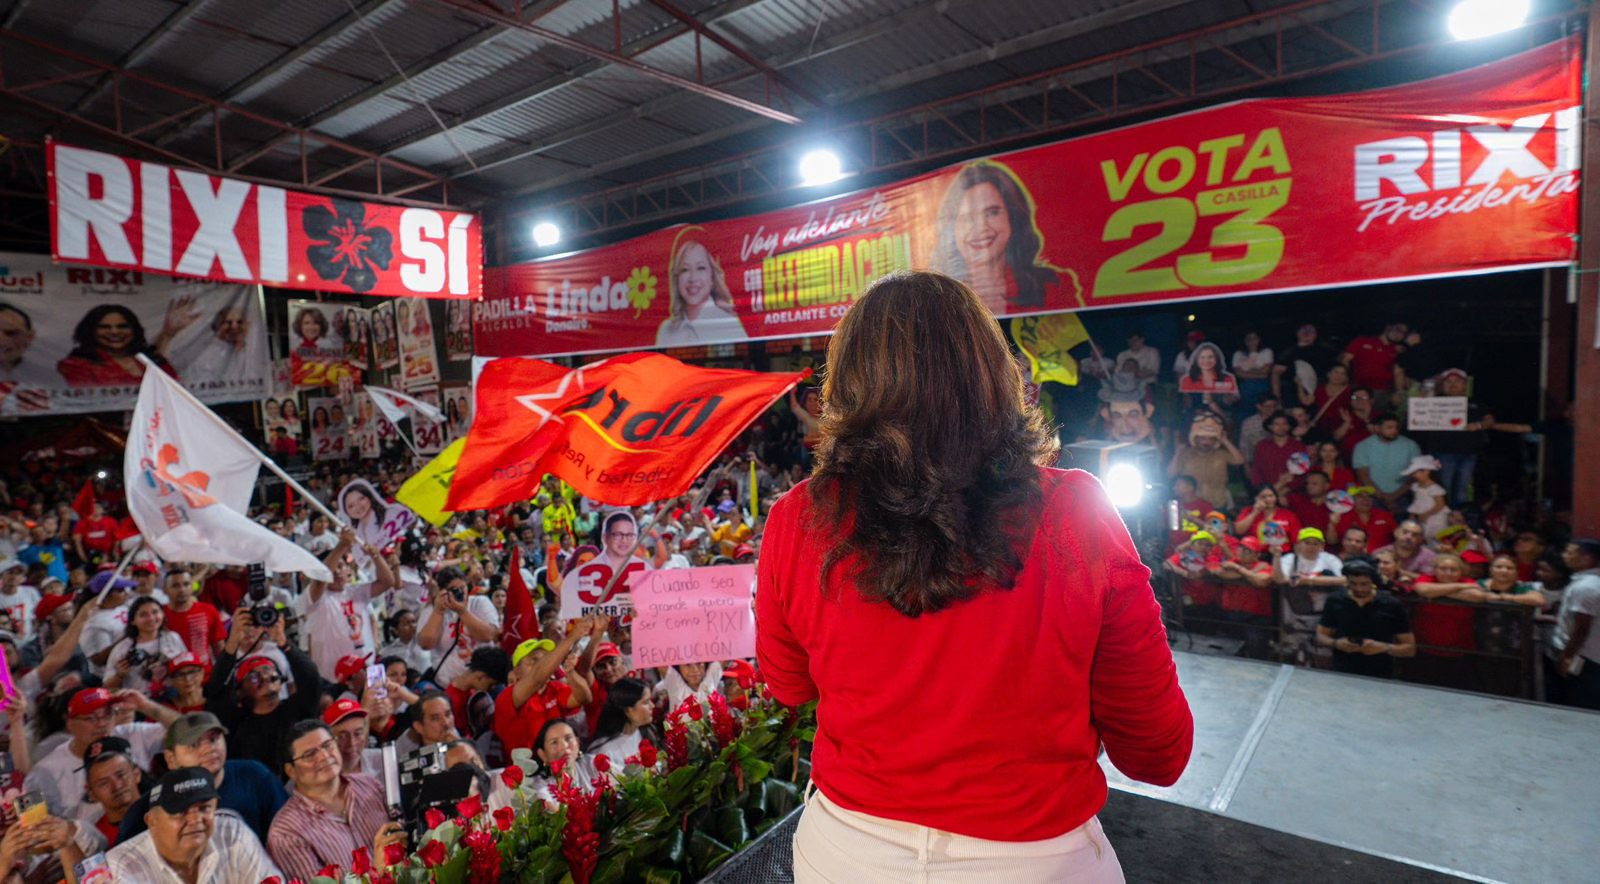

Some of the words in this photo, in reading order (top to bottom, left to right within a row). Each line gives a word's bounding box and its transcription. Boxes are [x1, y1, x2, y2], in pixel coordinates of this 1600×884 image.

[1101, 127, 1292, 202] VOTA
[1354, 106, 1583, 203] RIXI
[1212, 185, 1281, 206] CASILLA
[1357, 172, 1581, 233] Presidenta
[55, 145, 289, 283] RIXI
[741, 226, 778, 262] Voy
[783, 191, 890, 246] adelante
[1092, 177, 1293, 299] 23
[67, 267, 143, 286] RIXI
[763, 230, 912, 311] REFUNDACIÓN
[475, 295, 537, 321] PADILLA
[545, 276, 629, 318] Linda
[751, 290, 764, 312] LA
[764, 308, 827, 325] ADELANTE
[829, 304, 850, 319] CO
[303, 360, 350, 385] 26
[405, 355, 433, 378] 25
[318, 436, 345, 454] 24
[362, 434, 374, 451] 24
[416, 425, 442, 448] 34
[383, 509, 414, 538] 22
[578, 561, 646, 605] 34
[651, 571, 700, 594] Cuando
[711, 577, 735, 589] sea
[649, 598, 689, 618] grande
[698, 598, 735, 614] quiero
[639, 619, 657, 631] ser
[706, 609, 743, 633] RIXI
[639, 635, 733, 664] REVOLUCIÓN
